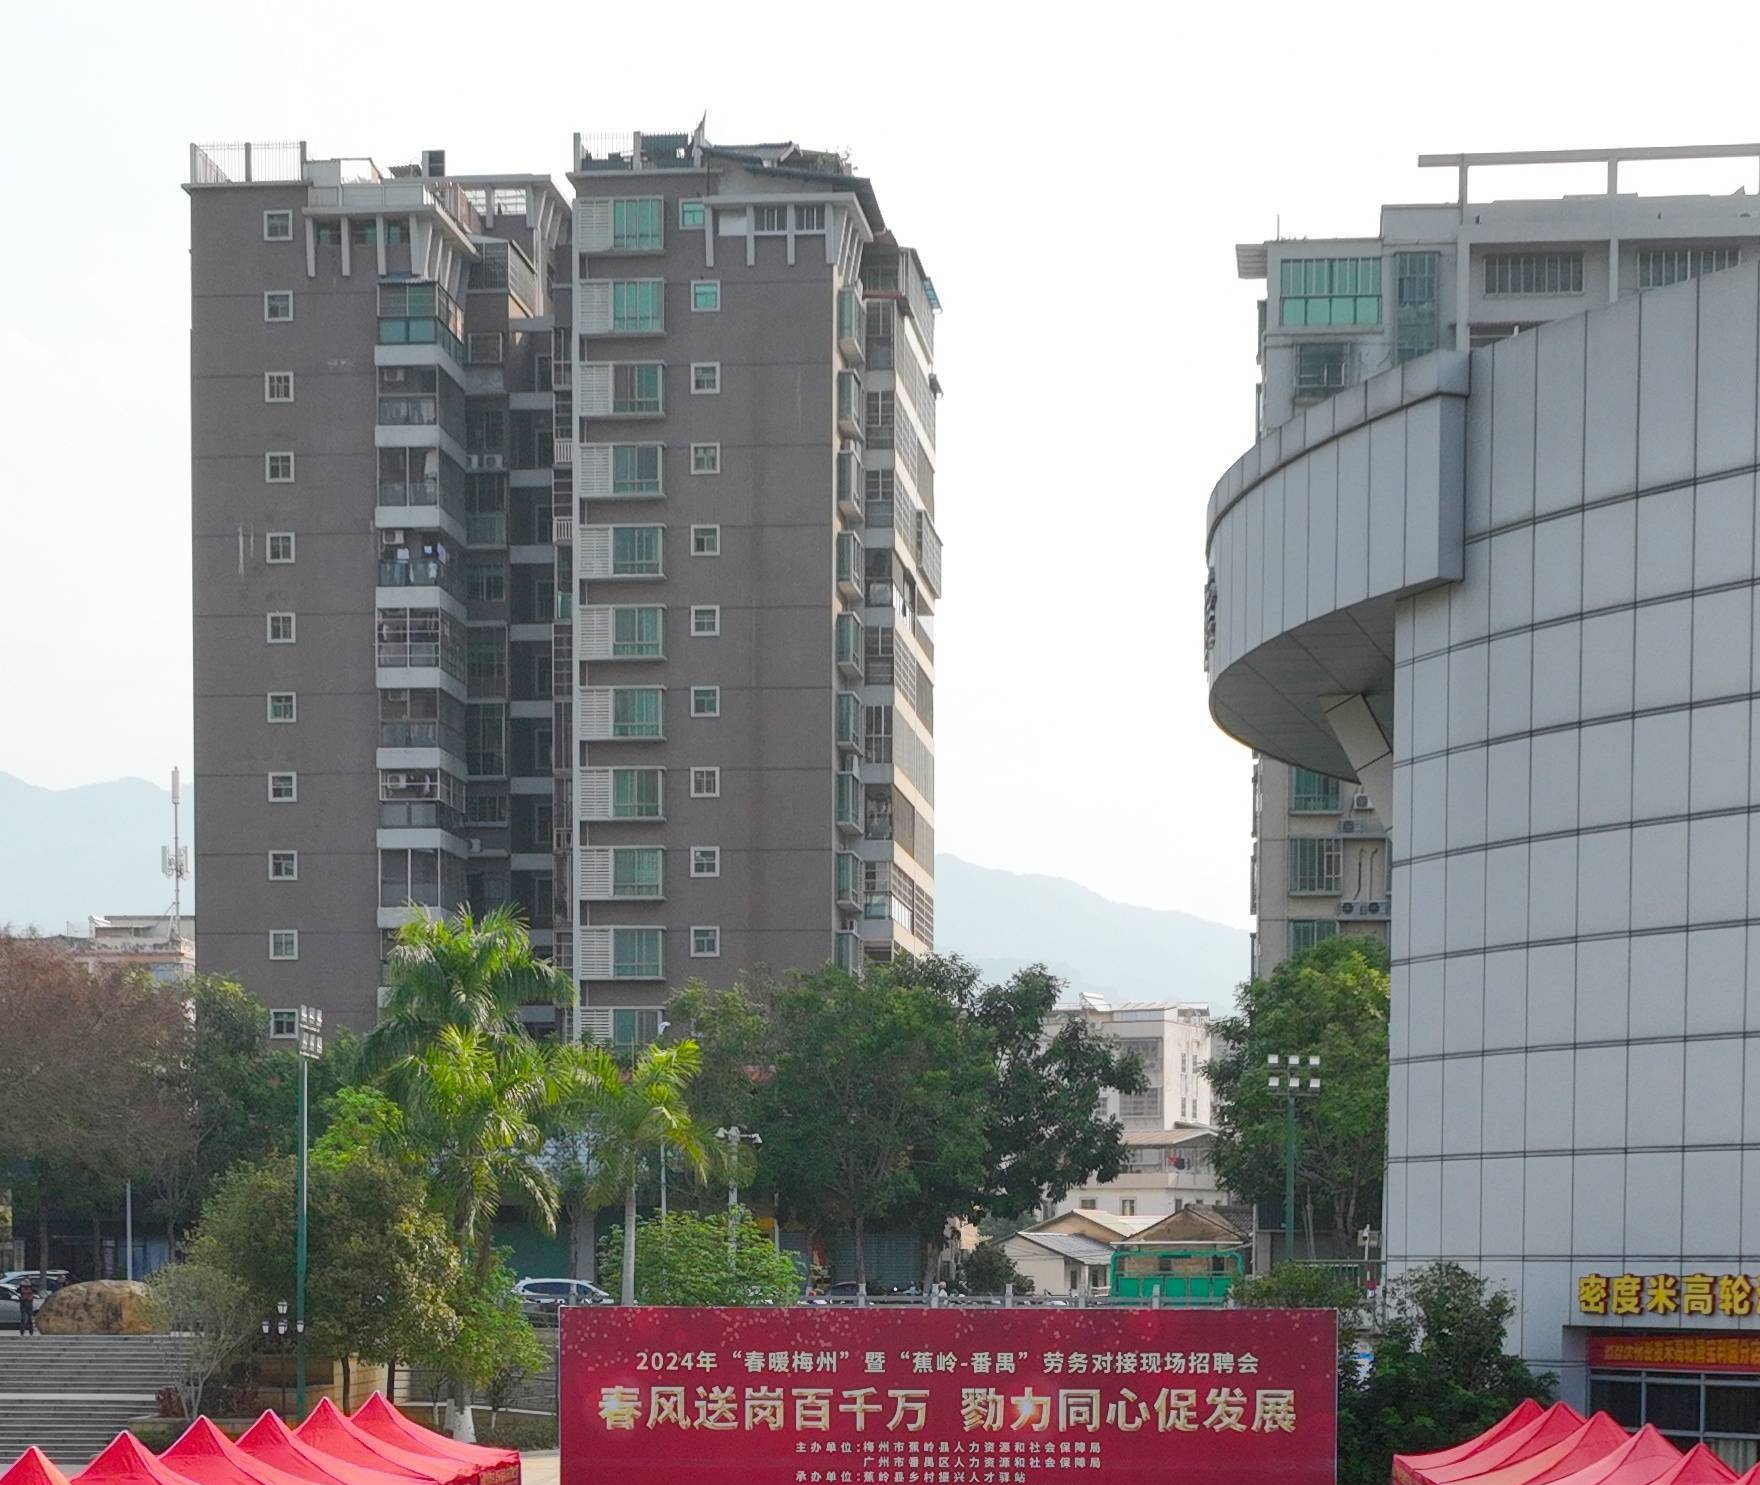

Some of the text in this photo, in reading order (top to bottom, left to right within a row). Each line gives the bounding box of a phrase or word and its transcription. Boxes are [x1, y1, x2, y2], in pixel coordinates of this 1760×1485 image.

[598, 1385, 930, 1432] 春风送岗百千万
[862, 1456, 1102, 1469] 广州市番禺区人力资源和社会保障局
